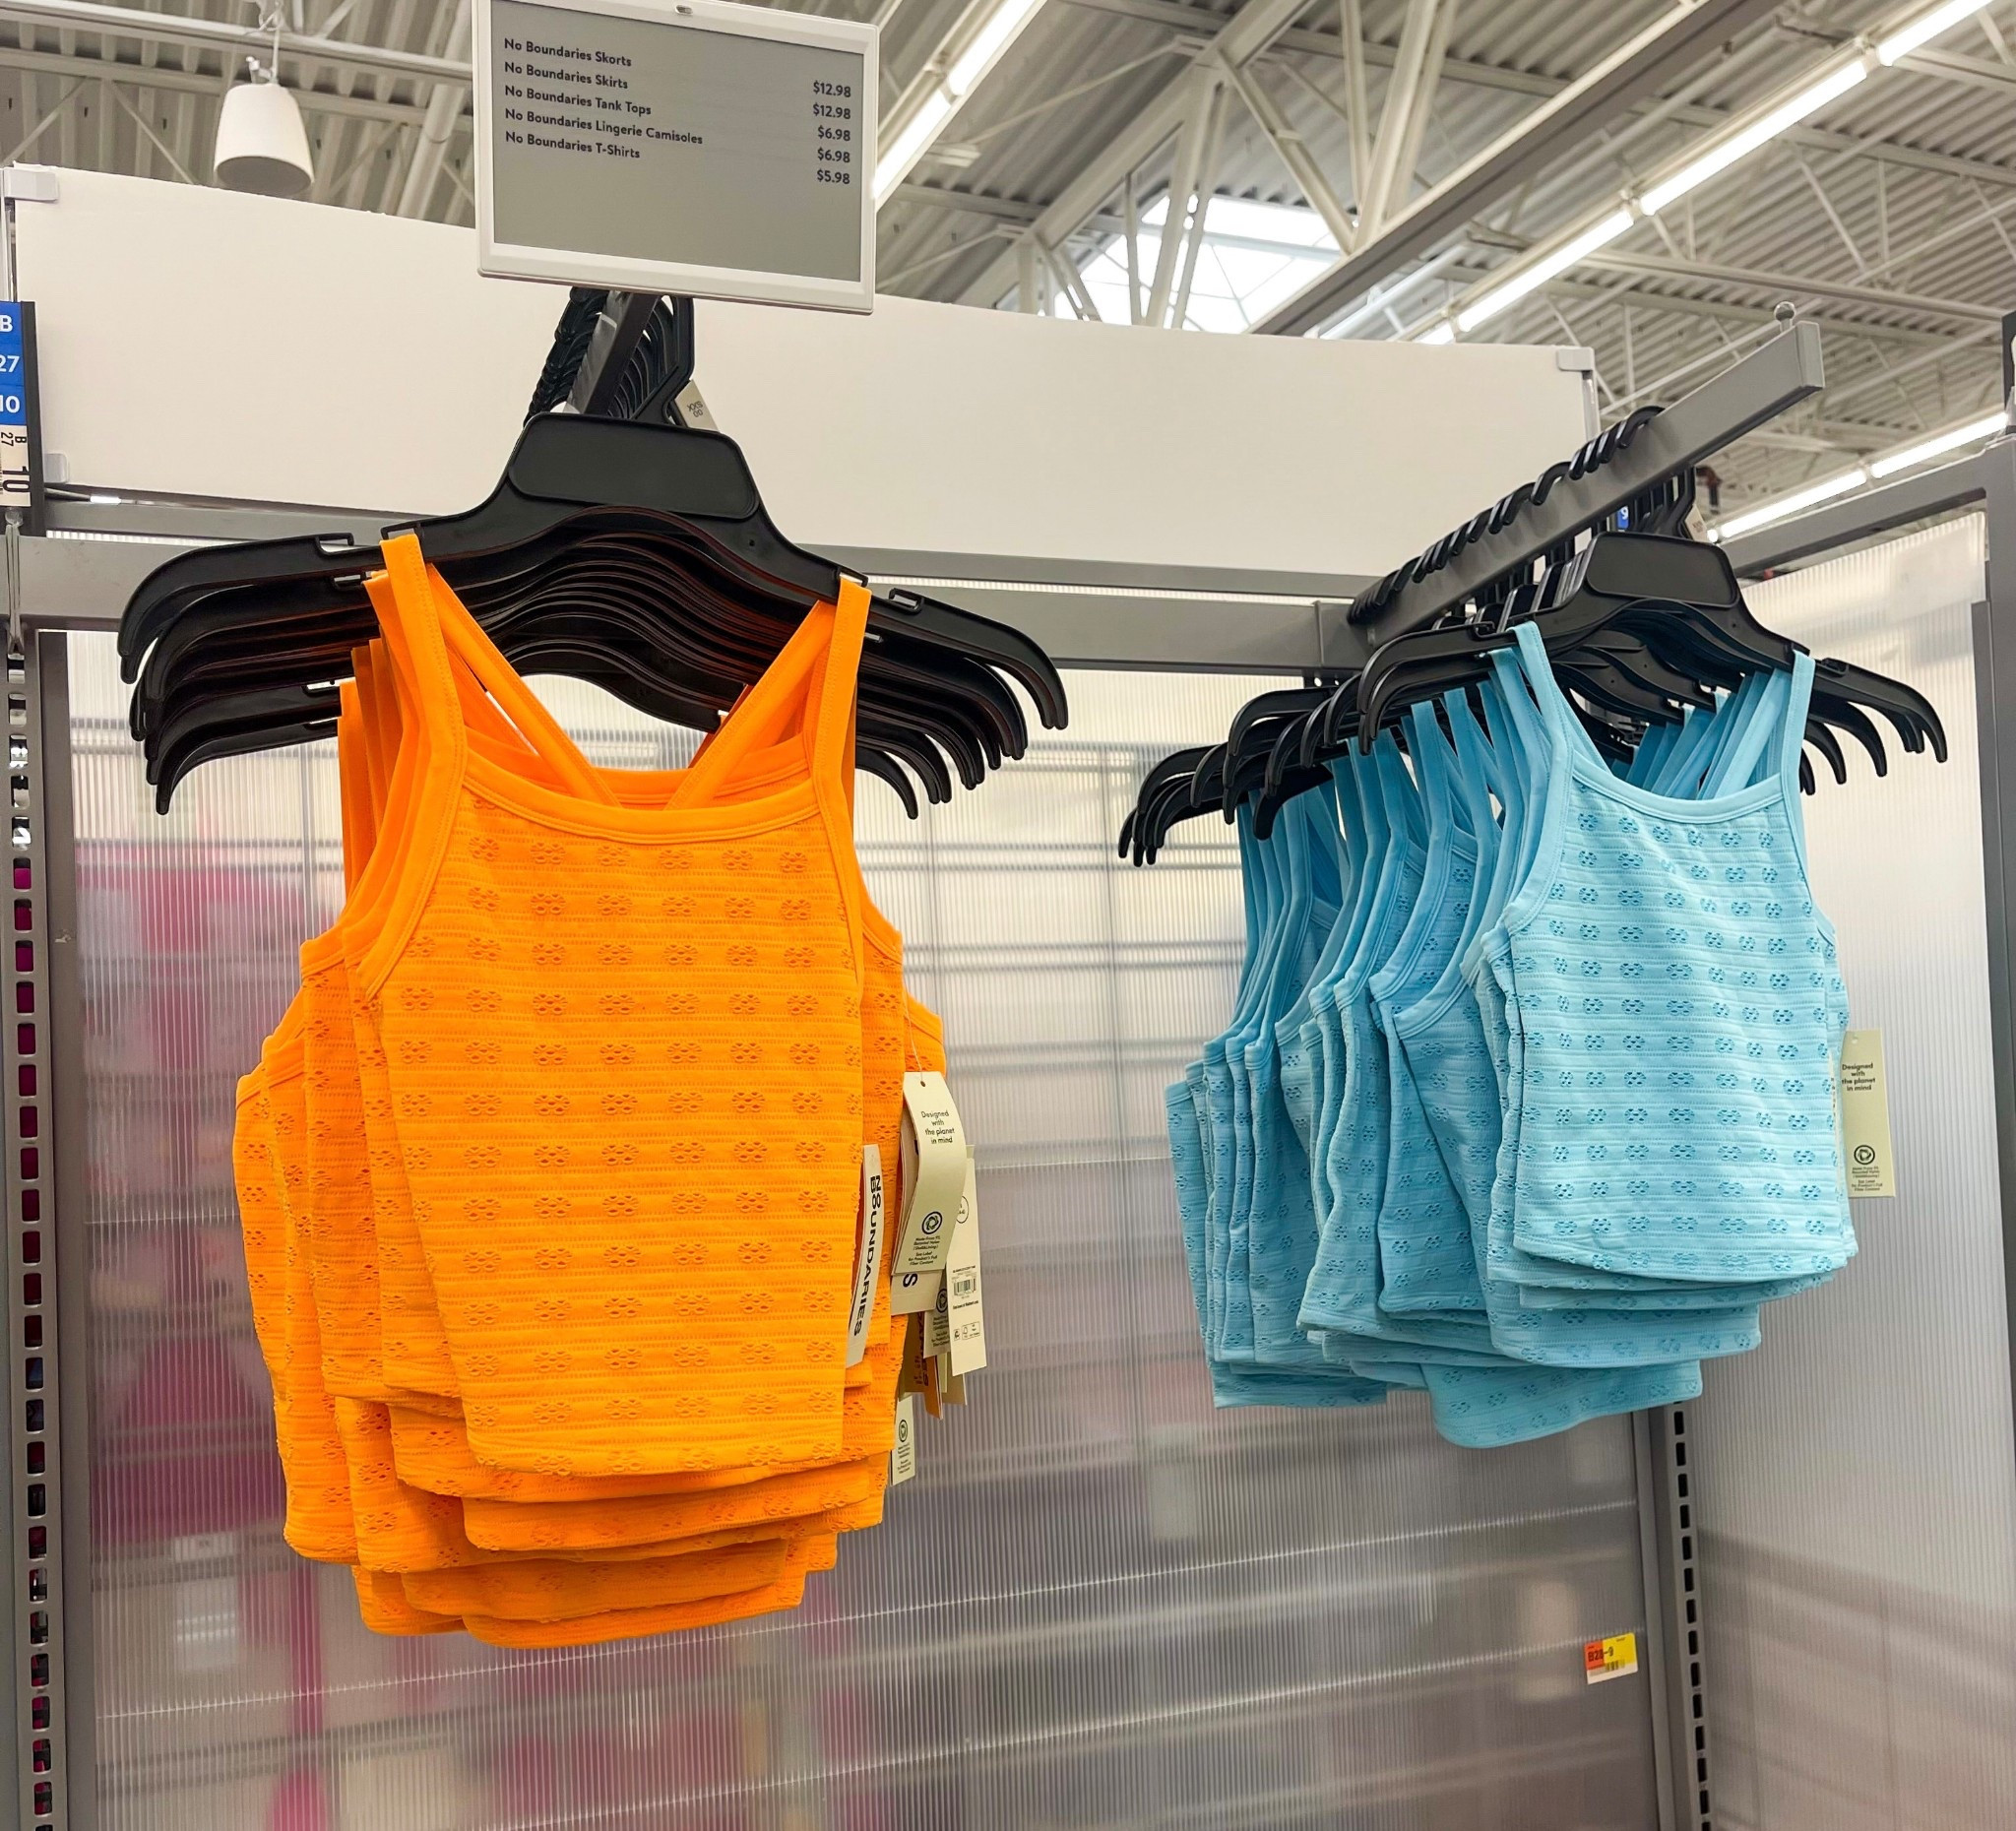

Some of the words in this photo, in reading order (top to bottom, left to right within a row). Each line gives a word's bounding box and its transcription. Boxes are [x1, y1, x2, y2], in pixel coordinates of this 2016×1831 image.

[504, 37, 522, 51] No
[526, 40, 592, 62] Boundaries
[596, 51, 632, 67] Skorts
[813, 80, 851, 98] $12.98
[504, 61, 523, 75] No
[527, 64, 592, 85] Boundaries
[596, 74, 628, 90] Skirts
[812, 102, 851, 120] $12.98
[505, 85, 523, 98] No
[527, 88, 593, 107] Boundaries
[596, 97, 622, 111] Tank
[625, 100, 652, 117] Tops
[817, 124, 850, 142] $6.98
[505, 107, 523, 121] No
[527, 110, 593, 130] Boundaries
[596, 120, 643, 137] Lingerie
[646, 127, 703, 145] Camisoles
[817, 147, 850, 163] $6.98
[505, 131, 524, 144] No
[528, 133, 593, 153] Boundaries
[596, 143, 641, 158] T-Shirts
[817, 168, 850, 185] $5.98
[0, 314, 14, 333] B
[0, 431, 14, 447] 27
[14, 435, 28, 444] B
[2, 465, 31, 493] 10
[1841, 1062, 1873, 1071] Designed
[920, 1109, 949, 1120] Designed
[936, 1127, 955, 1136] planet
[853, 1175, 877, 1337] BOUNDARIES
